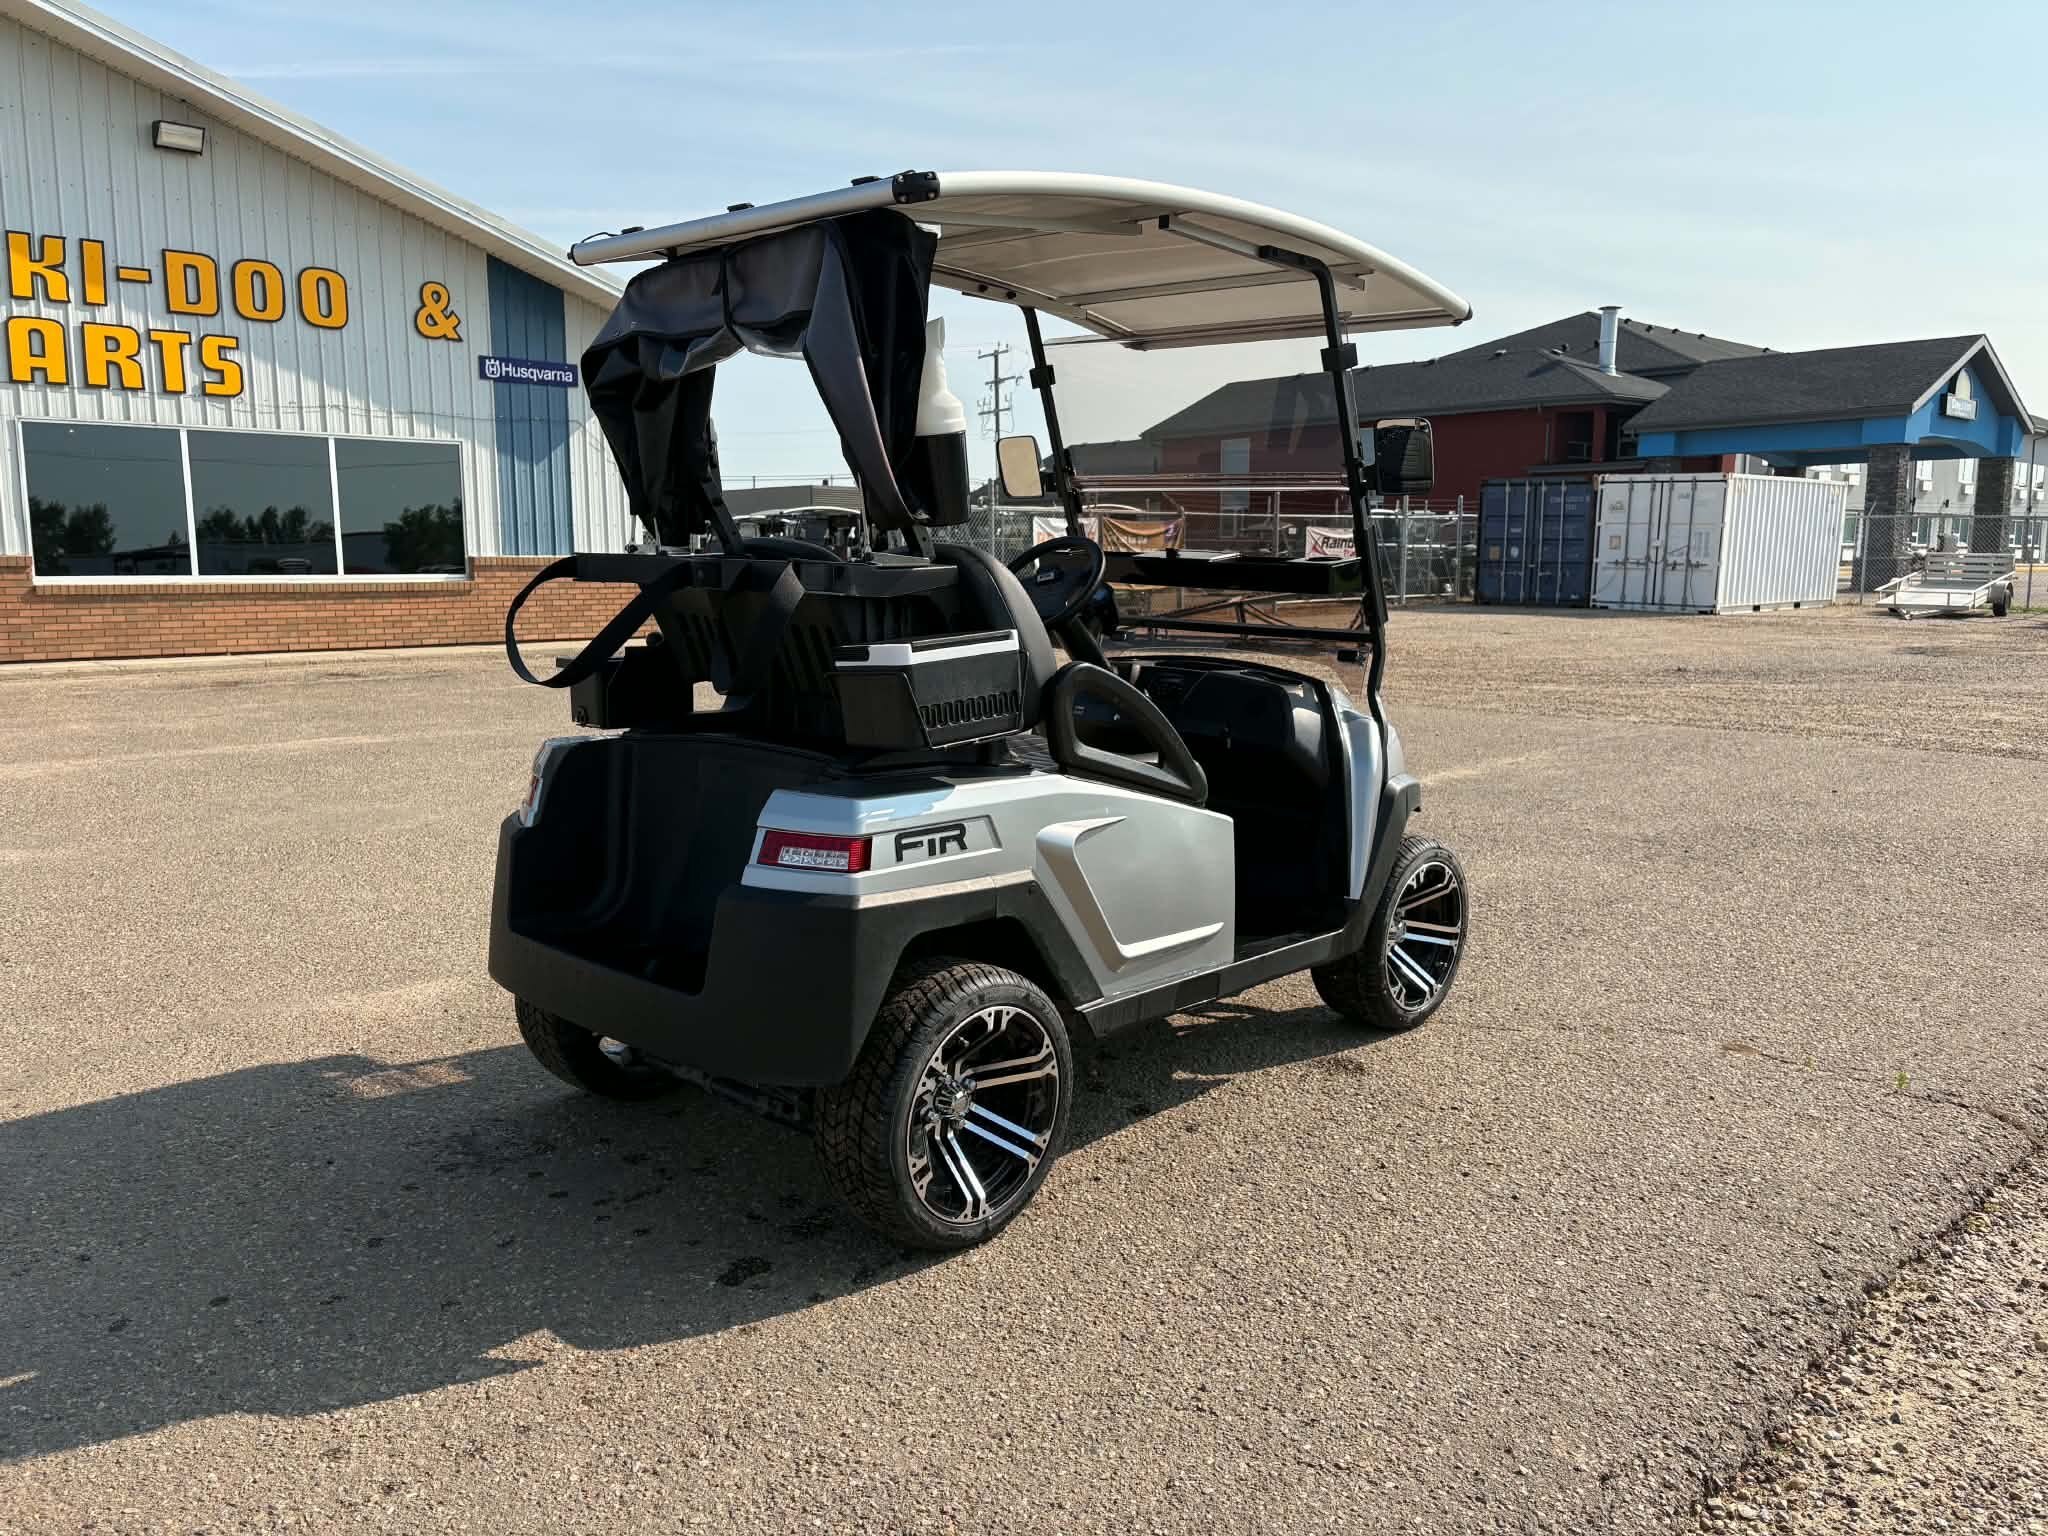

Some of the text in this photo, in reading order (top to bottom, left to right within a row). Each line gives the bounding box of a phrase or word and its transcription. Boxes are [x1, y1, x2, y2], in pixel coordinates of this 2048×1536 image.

[5, 230, 464, 342] KI-DOO &
[6, 316, 244, 398] ARTS
[501, 362, 573, 382] Husqvarna
